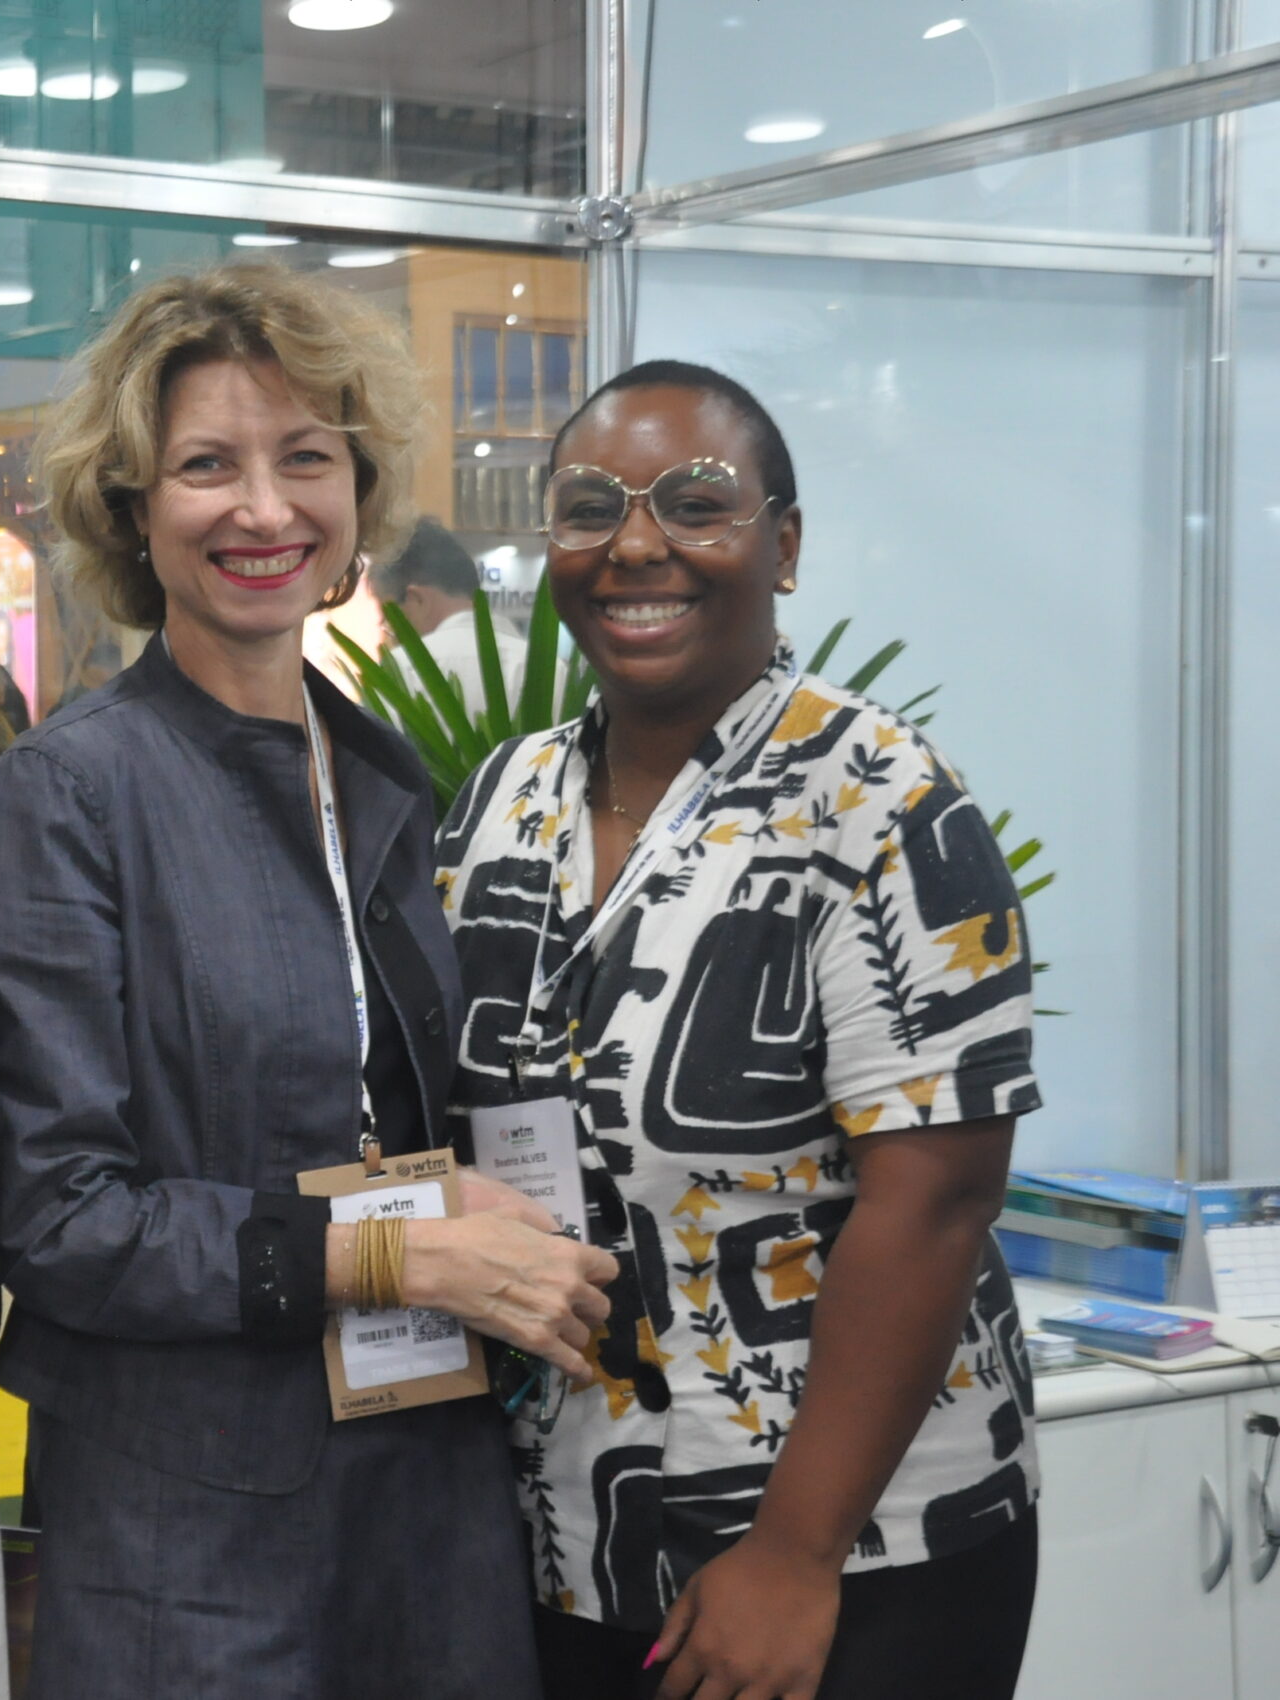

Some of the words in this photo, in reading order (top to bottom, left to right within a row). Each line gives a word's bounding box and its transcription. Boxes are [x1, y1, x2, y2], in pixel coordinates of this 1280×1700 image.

[666, 783, 711, 834] ILHABELA
[327, 818, 343, 876] ILHABELA
[511, 1125, 534, 1138] wtm
[412, 1157, 446, 1173] wtm
[520, 1152, 547, 1164] ALVES
[379, 1198, 415, 1214] wtm
